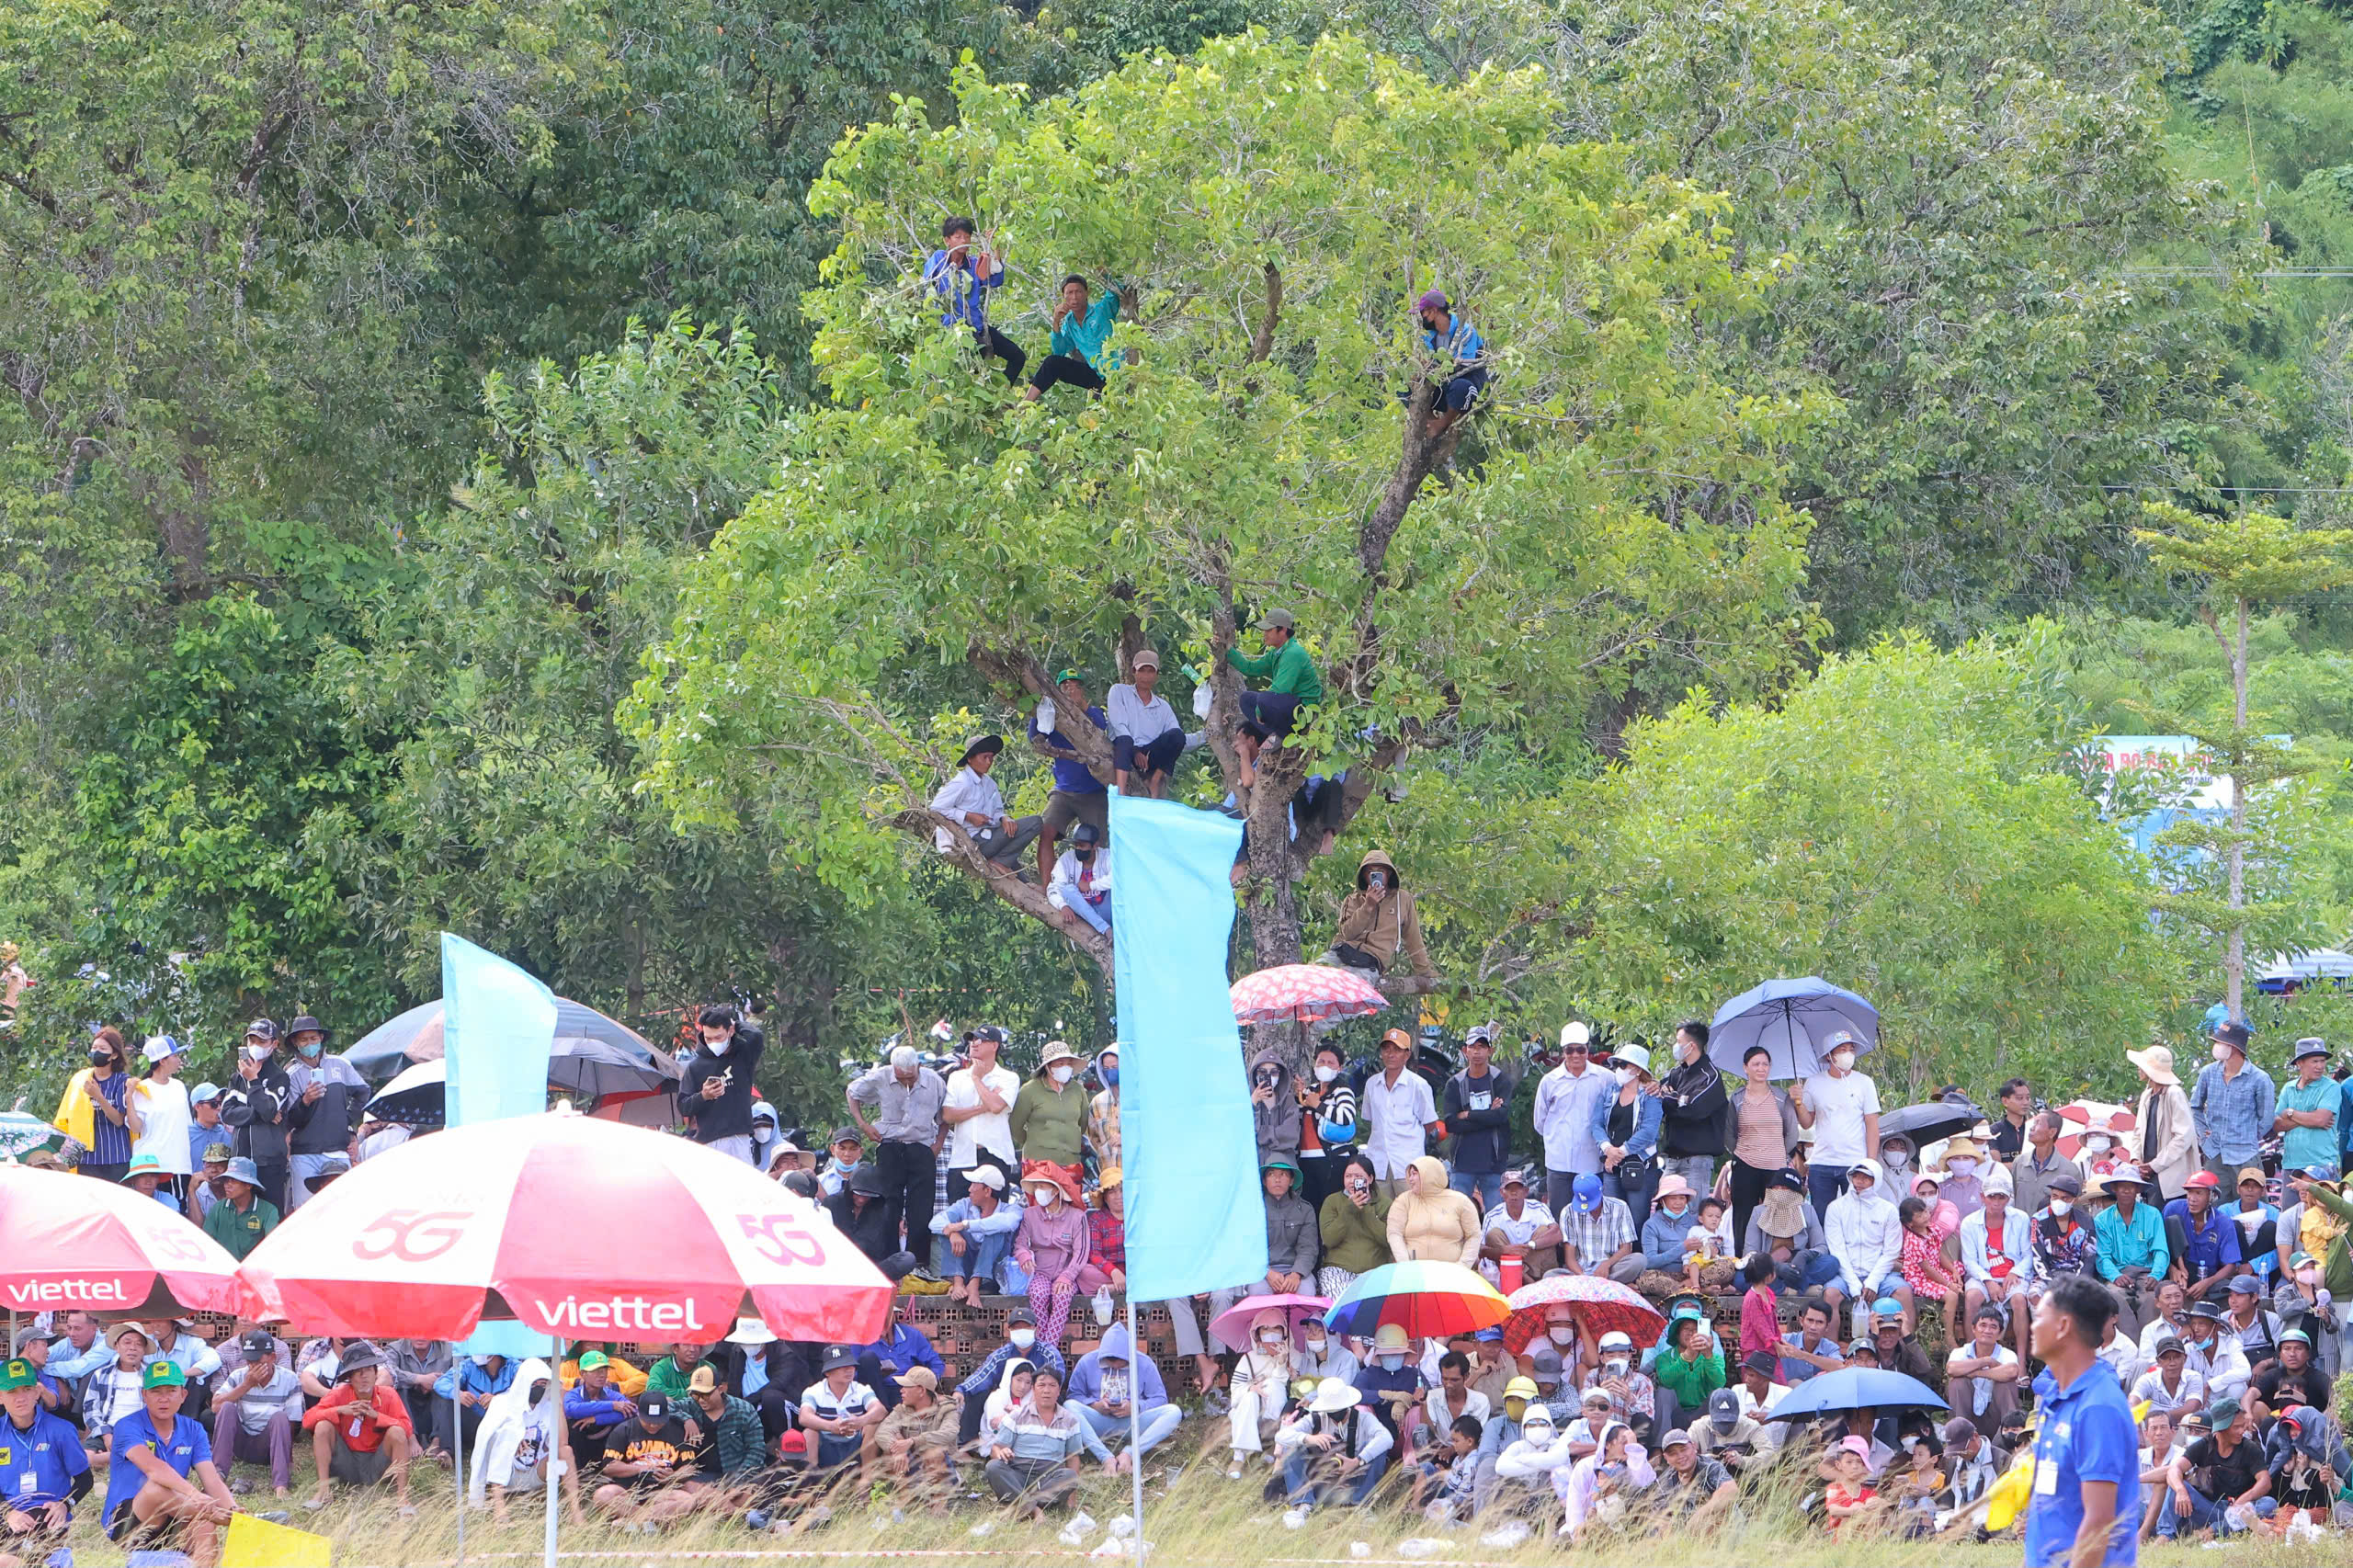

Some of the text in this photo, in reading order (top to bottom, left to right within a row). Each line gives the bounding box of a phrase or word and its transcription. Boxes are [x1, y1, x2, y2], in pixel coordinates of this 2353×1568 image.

[353, 1208, 475, 1263] 5G
[735, 1213, 826, 1267] 5G
[7, 1278, 128, 1302] viettel
[535, 1295, 704, 1331] viettel
